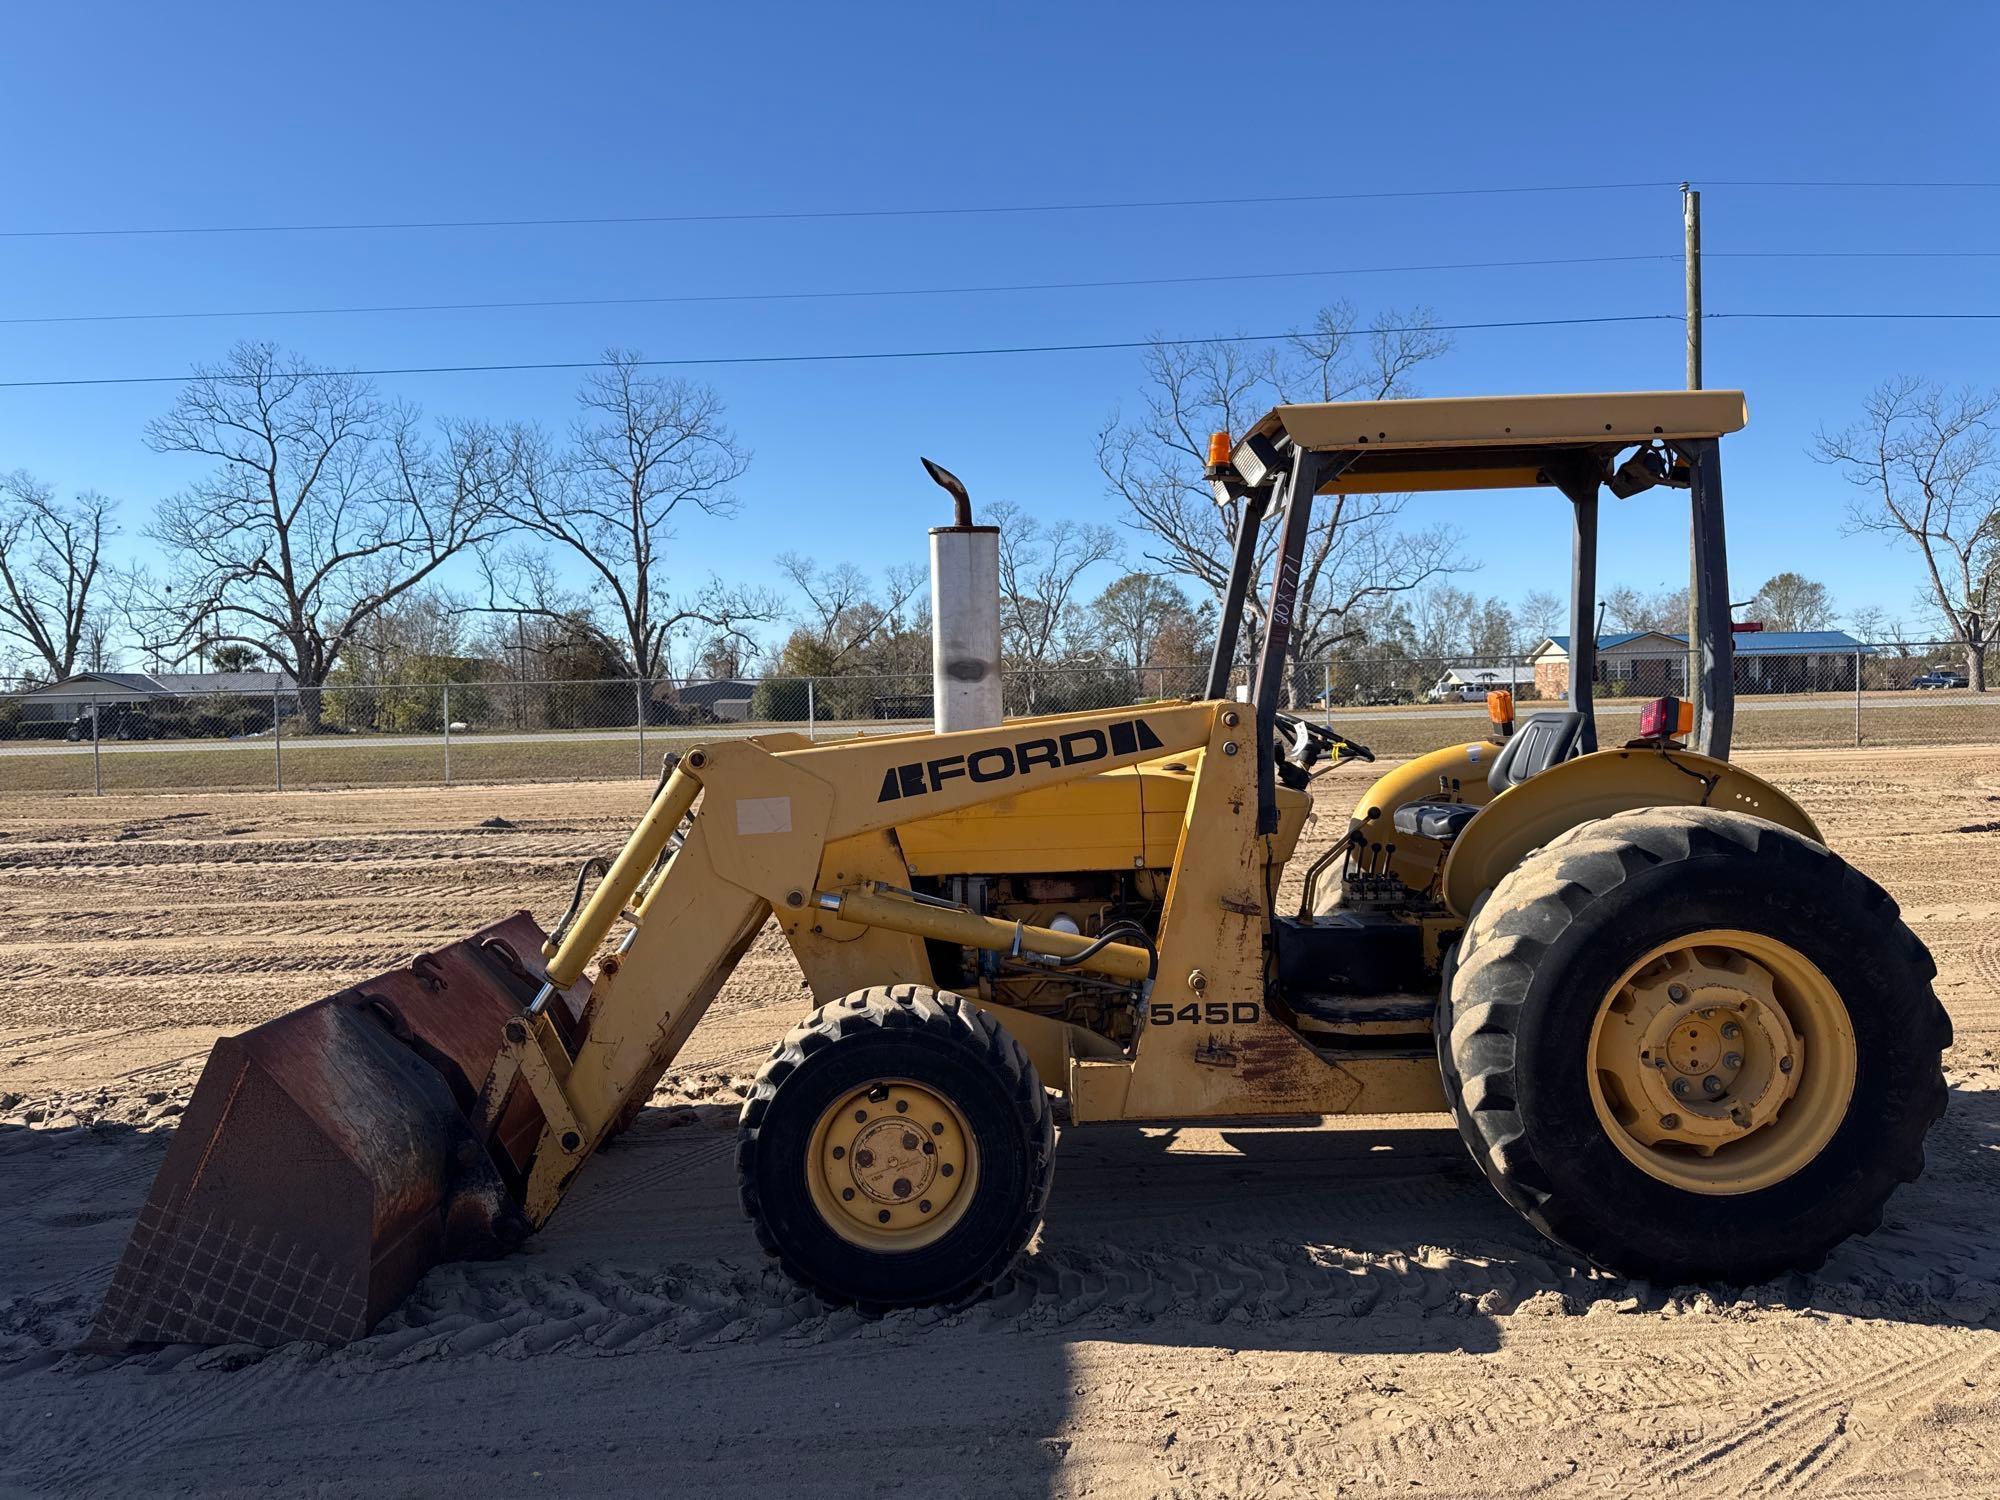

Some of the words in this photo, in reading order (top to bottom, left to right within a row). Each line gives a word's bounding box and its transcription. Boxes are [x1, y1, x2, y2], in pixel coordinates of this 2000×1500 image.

[1273, 554, 1300, 625] 208771
[926, 729, 1108, 792] FORD
[1150, 1002, 1260, 1026] 545D
